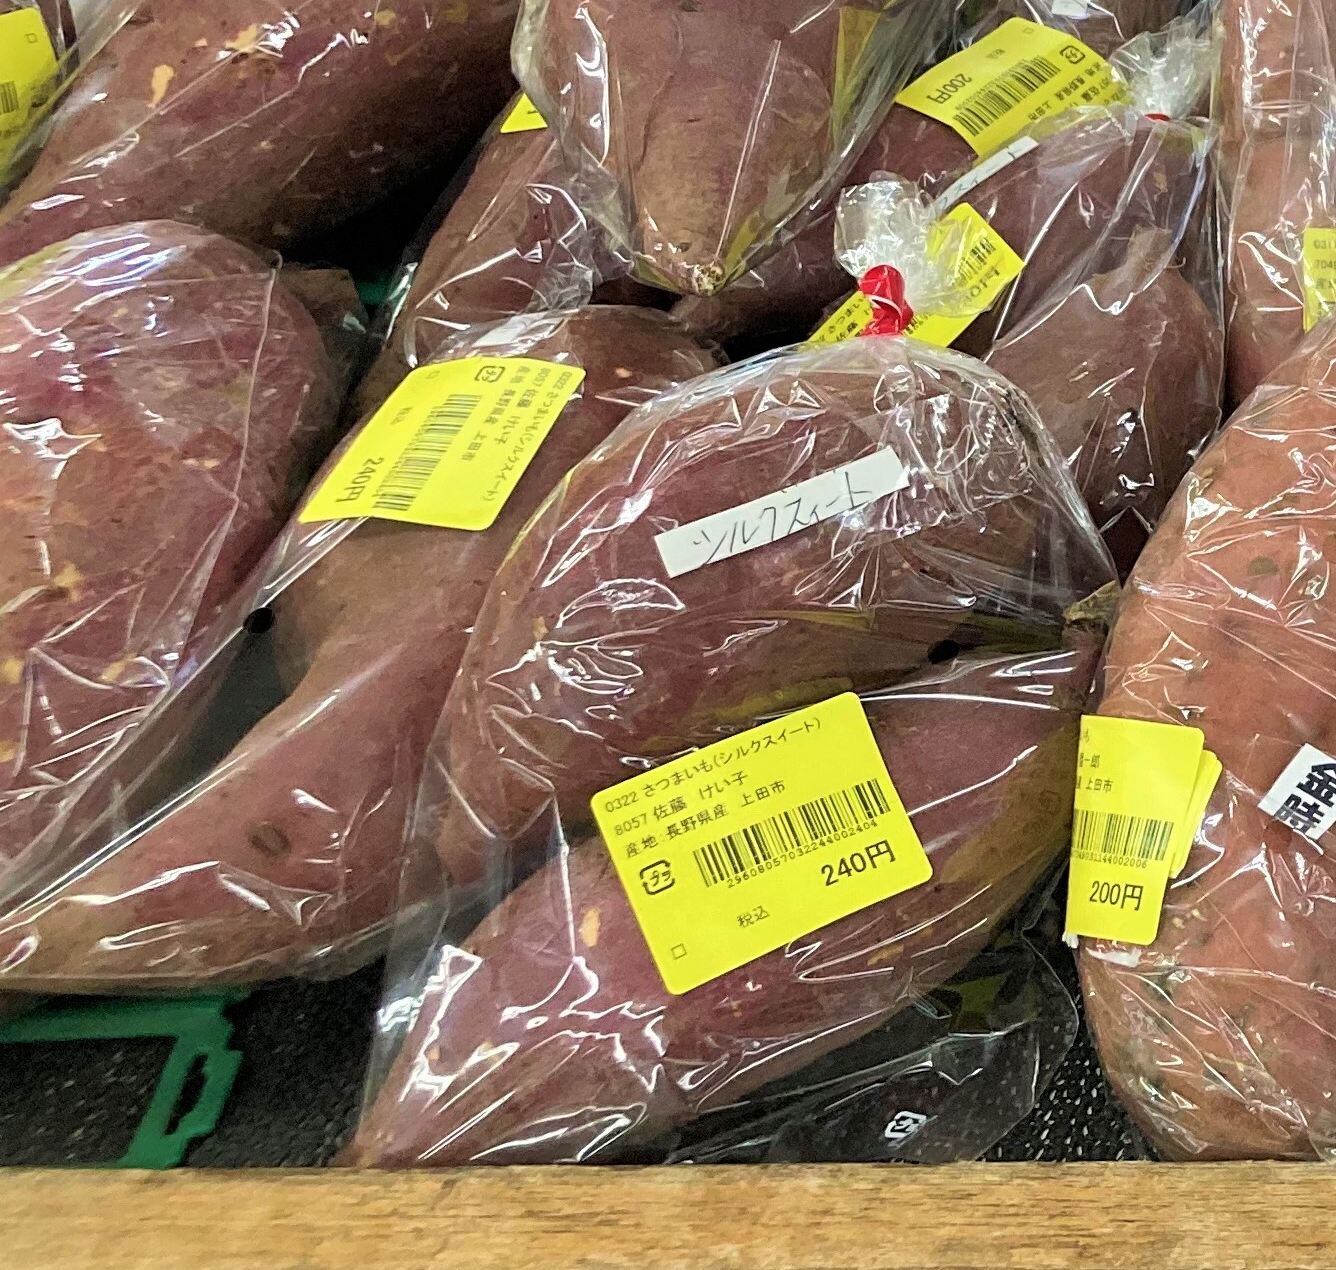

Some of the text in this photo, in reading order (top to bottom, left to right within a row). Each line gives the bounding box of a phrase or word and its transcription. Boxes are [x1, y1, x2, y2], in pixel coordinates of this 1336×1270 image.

[926, 72, 973, 105] 200円
[335, 456, 384, 503] 240円
[605, 791, 638, 813] 0322
[614, 770, 749, 836] 8057 佐藤 けい子
[740, 781, 786, 809] 上田市
[821, 838, 897, 888] 240円
[1089, 880, 1144, 912] 200円
[736, 905, 771, 929] 税込
